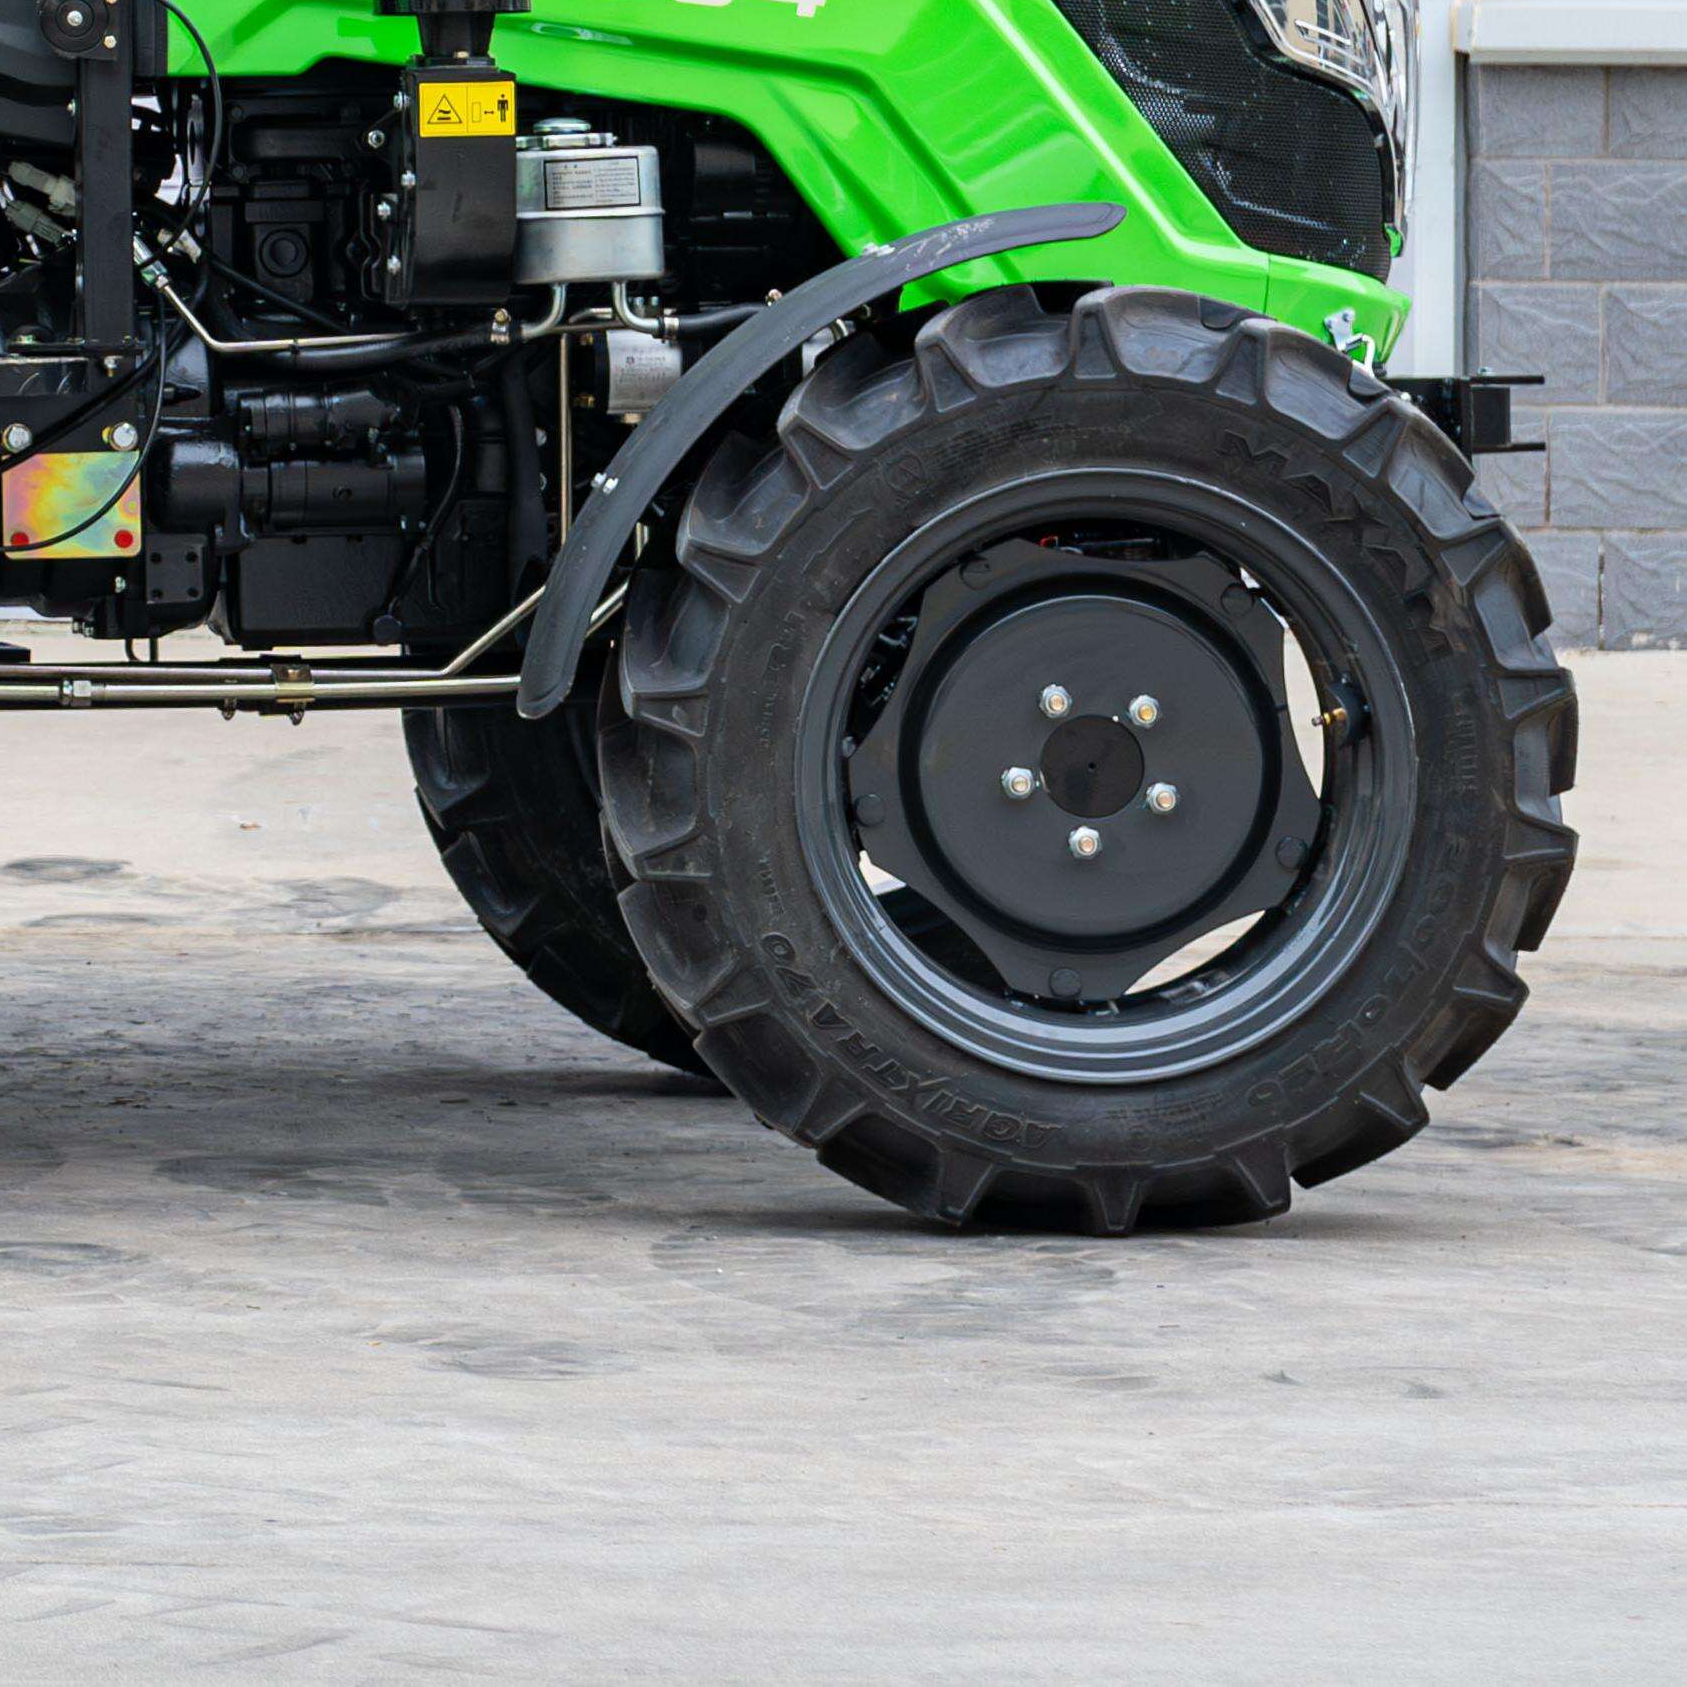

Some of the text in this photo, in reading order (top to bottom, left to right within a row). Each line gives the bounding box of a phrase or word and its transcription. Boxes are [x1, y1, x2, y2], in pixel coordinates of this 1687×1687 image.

[1219, 427, 1457, 662] MAXAM
[760, 931, 818, 1006] 70
[812, 1000, 1061, 1147] AGRIXTRA
